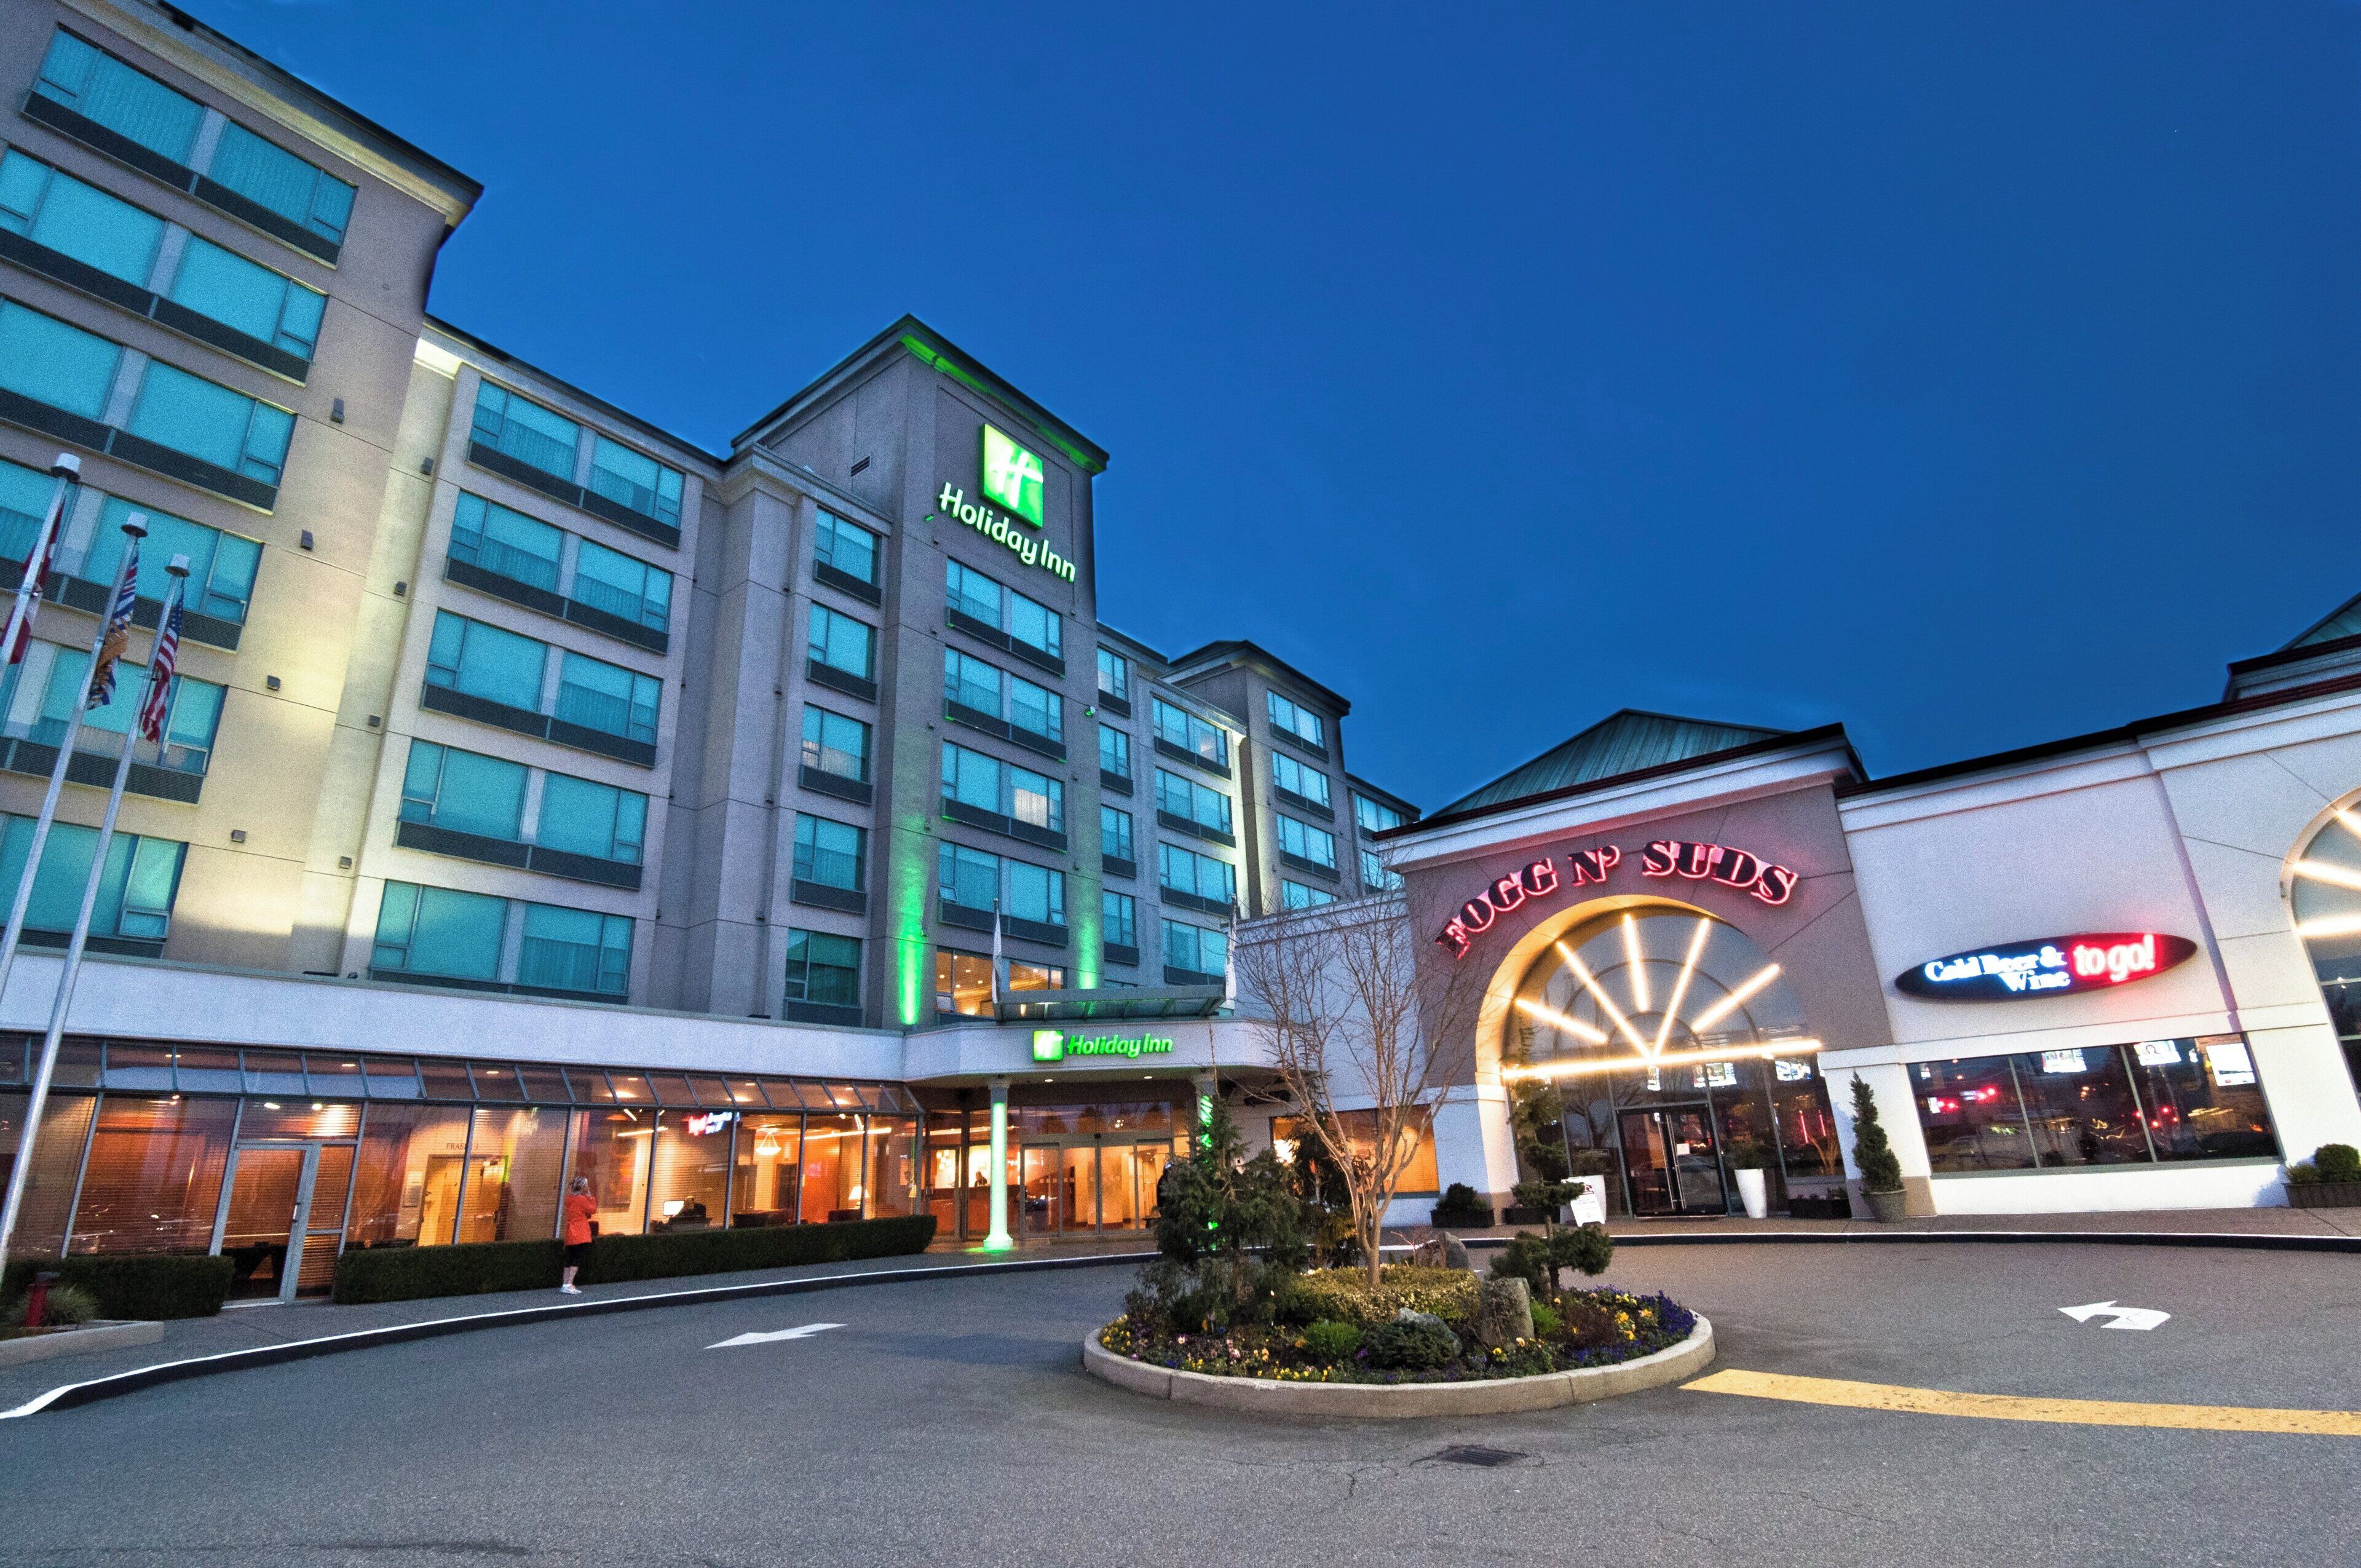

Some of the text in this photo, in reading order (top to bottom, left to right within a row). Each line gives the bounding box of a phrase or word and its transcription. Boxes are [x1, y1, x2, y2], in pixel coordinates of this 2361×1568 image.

[939, 481, 1076, 583] Holiday Inn
[1434, 857, 1559, 960] FOGG
[1641, 840, 1799, 905] SUDS
[1924, 946, 2068, 981] Cold Beer &
[2073, 934, 2155, 983] to go!
[1998, 969, 2071, 991] Wine
[1067, 1034, 1142, 1059] Holiday
[1142, 1033, 1174, 1053] Inn
